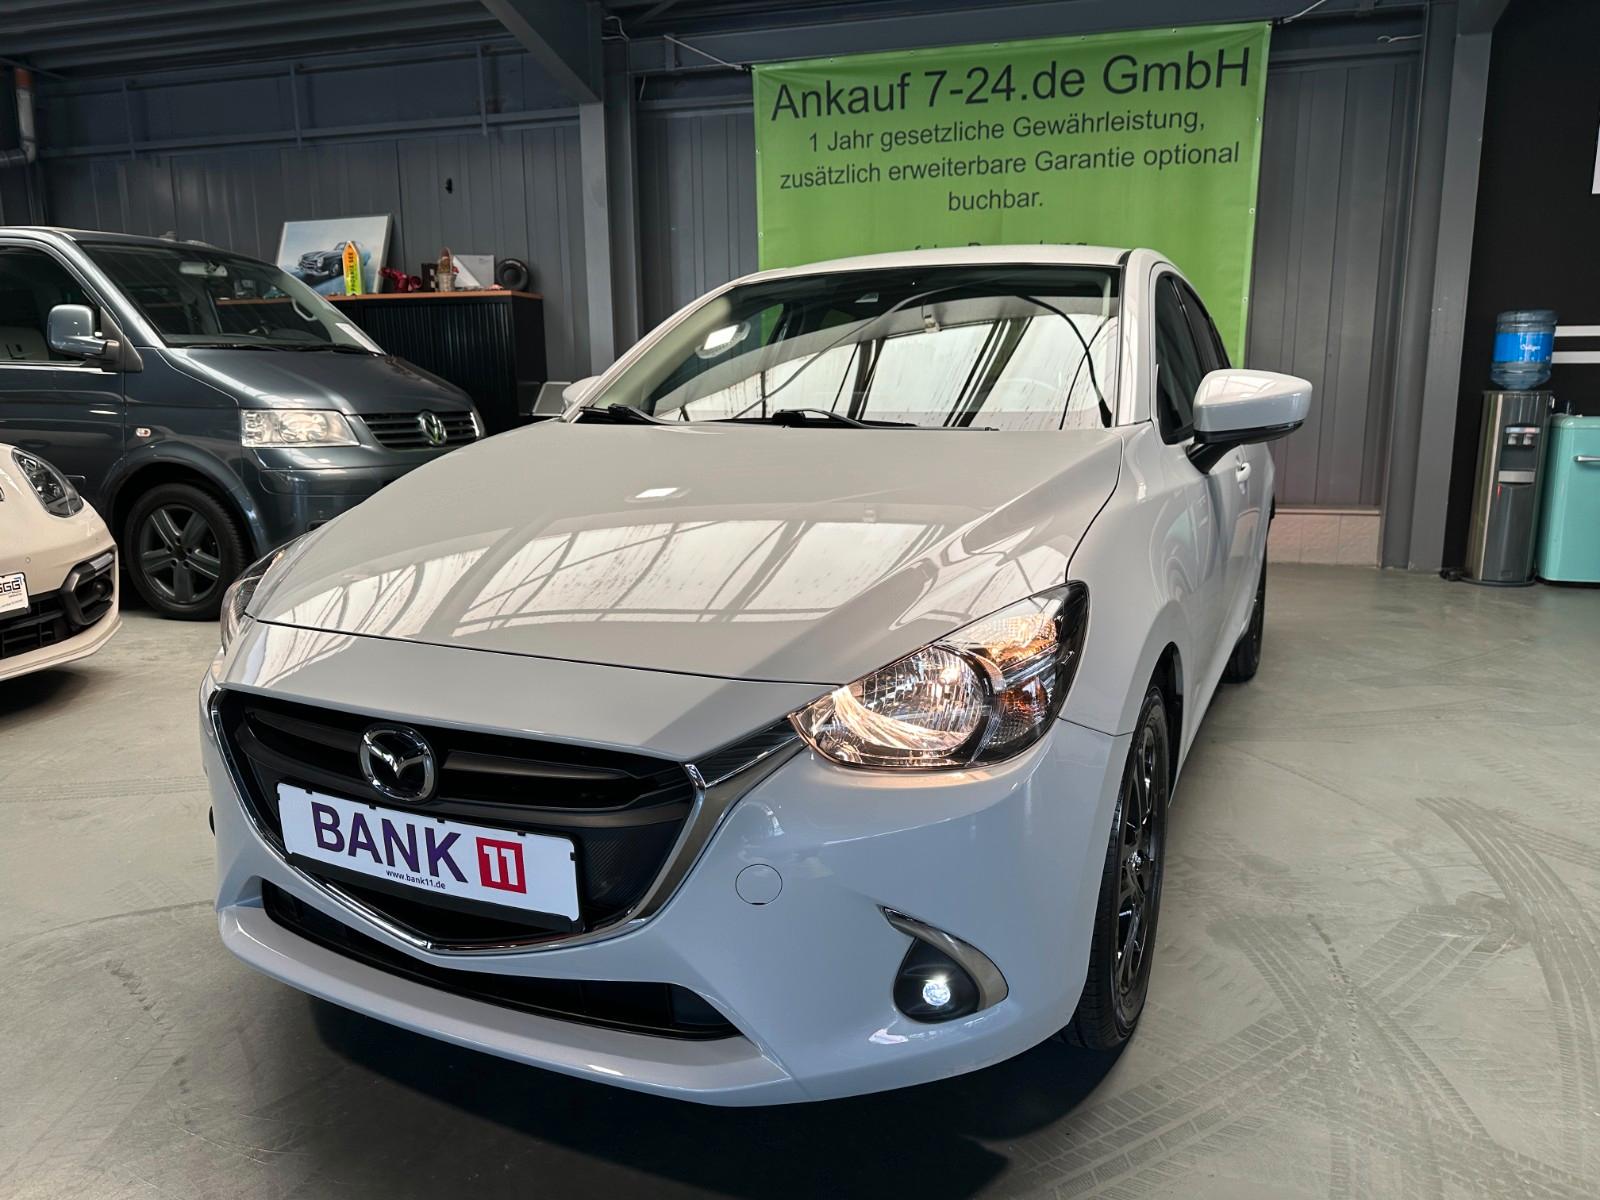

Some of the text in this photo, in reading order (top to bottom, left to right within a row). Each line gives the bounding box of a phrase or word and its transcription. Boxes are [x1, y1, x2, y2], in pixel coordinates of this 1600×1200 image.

[771, 46, 1250, 121] Ankauf 7-24.de GmbH
[808, 109, 1205, 153] 1 Jahr gesetzliche Gewährleistung,
[779, 141, 1240, 190] zusätzlich erweiterbare Garantie optional
[948, 188, 1044, 212] buchbar.
[311, 801, 520, 888] BANK 11
[385, 868, 447, 890] www.bank11.de
